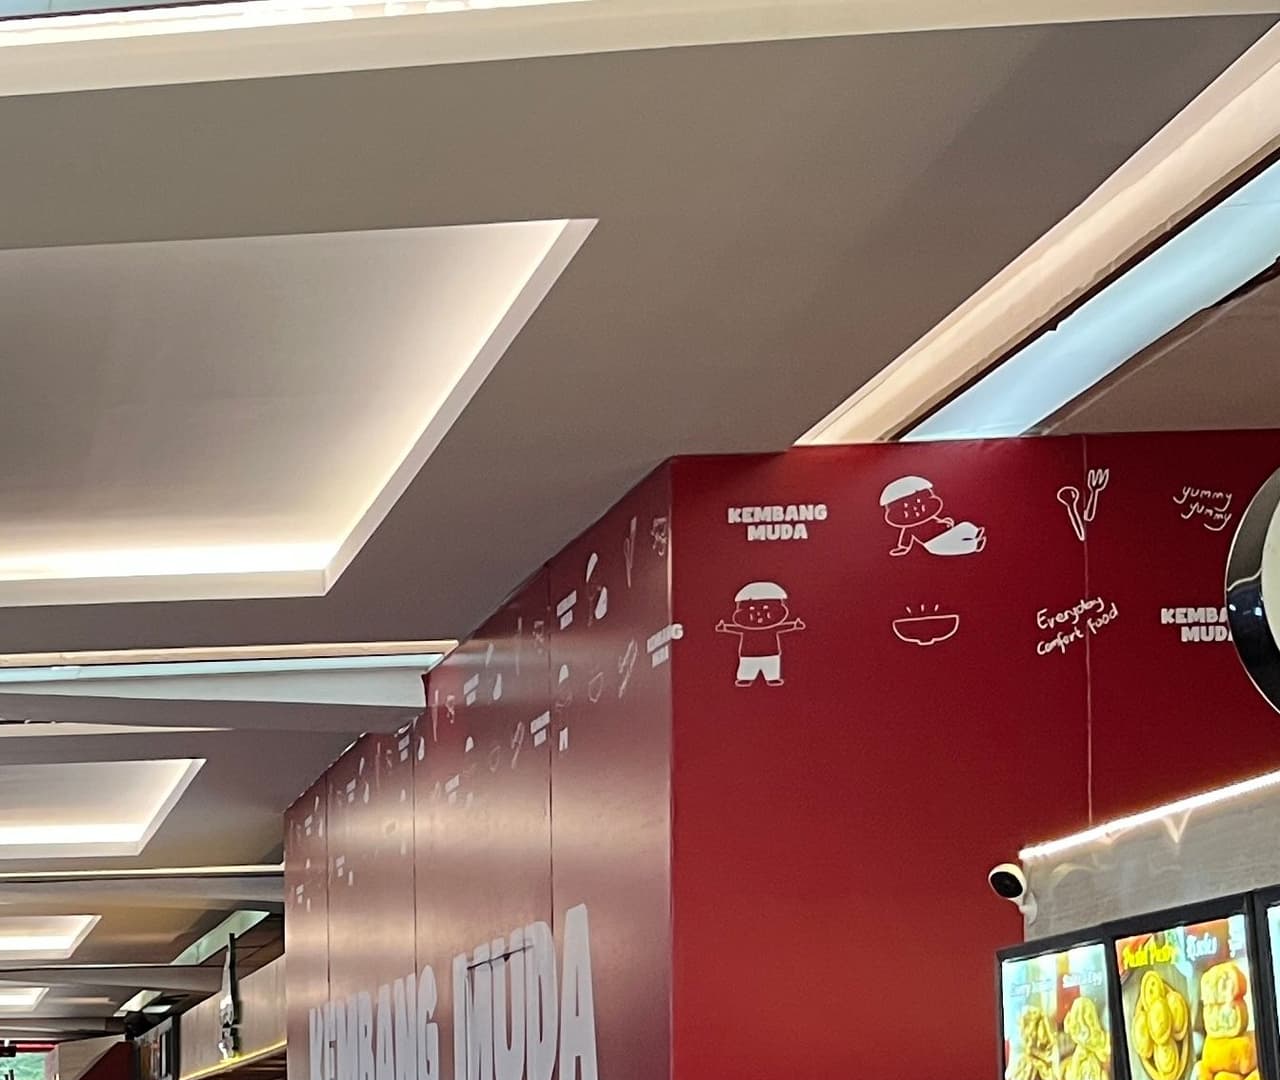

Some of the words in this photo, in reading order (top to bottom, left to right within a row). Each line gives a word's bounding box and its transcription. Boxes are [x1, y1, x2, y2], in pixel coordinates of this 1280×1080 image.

[1172, 486, 1233, 512] yummy
[728, 504, 828, 523] KEMBANG
[1180, 502, 1233, 531] yummy
[747, 523, 808, 541] MUDA
[1036, 597, 1104, 630] Everyday
[1161, 607, 1229, 625] KEMBA
